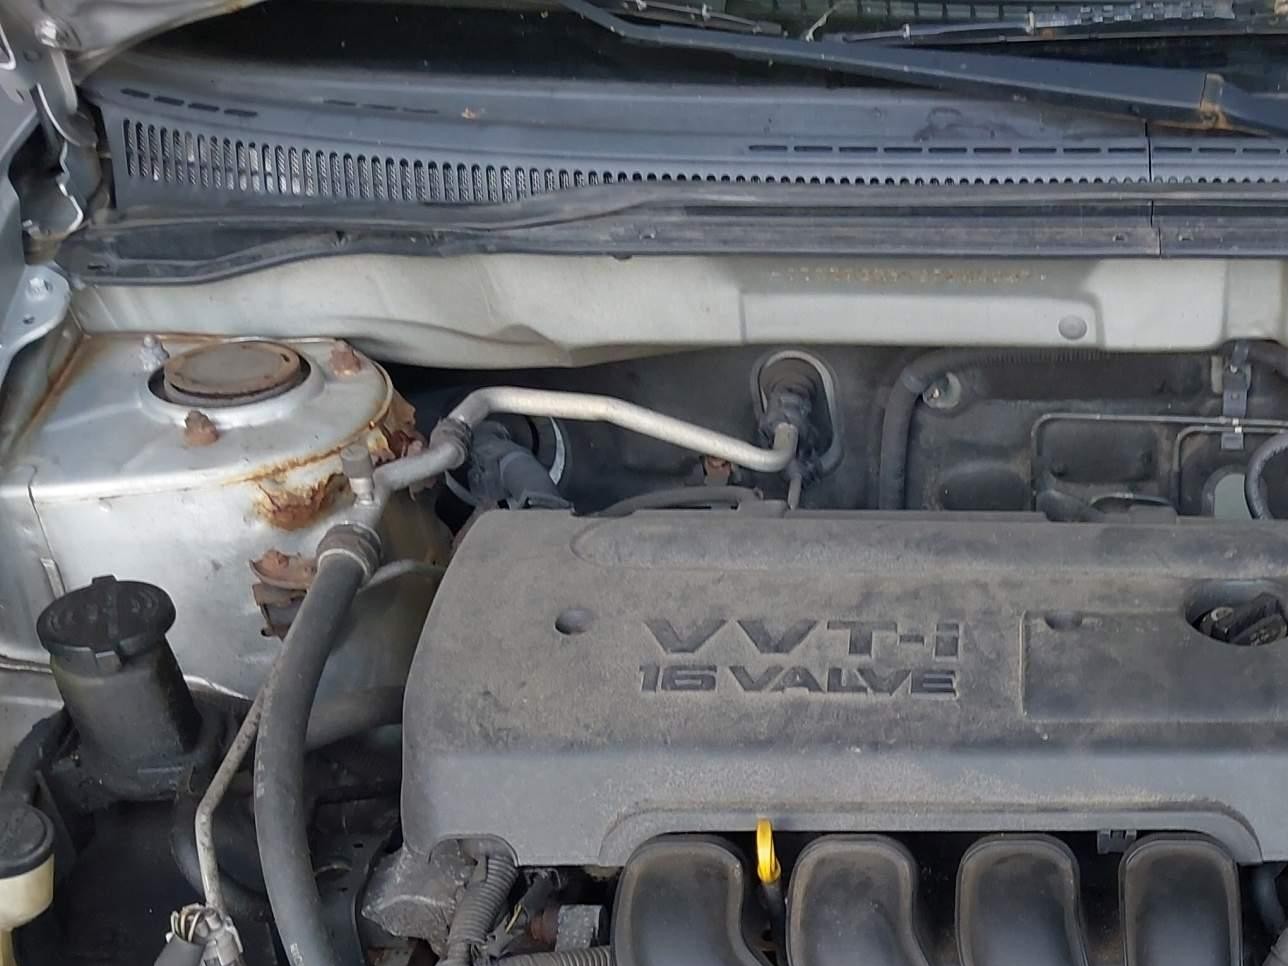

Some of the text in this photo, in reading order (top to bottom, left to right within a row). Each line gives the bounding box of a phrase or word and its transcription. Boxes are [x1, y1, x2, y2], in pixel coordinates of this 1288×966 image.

[645, 619, 960, 657] VVT-i
[639, 665, 957, 695] 16 VALVE
